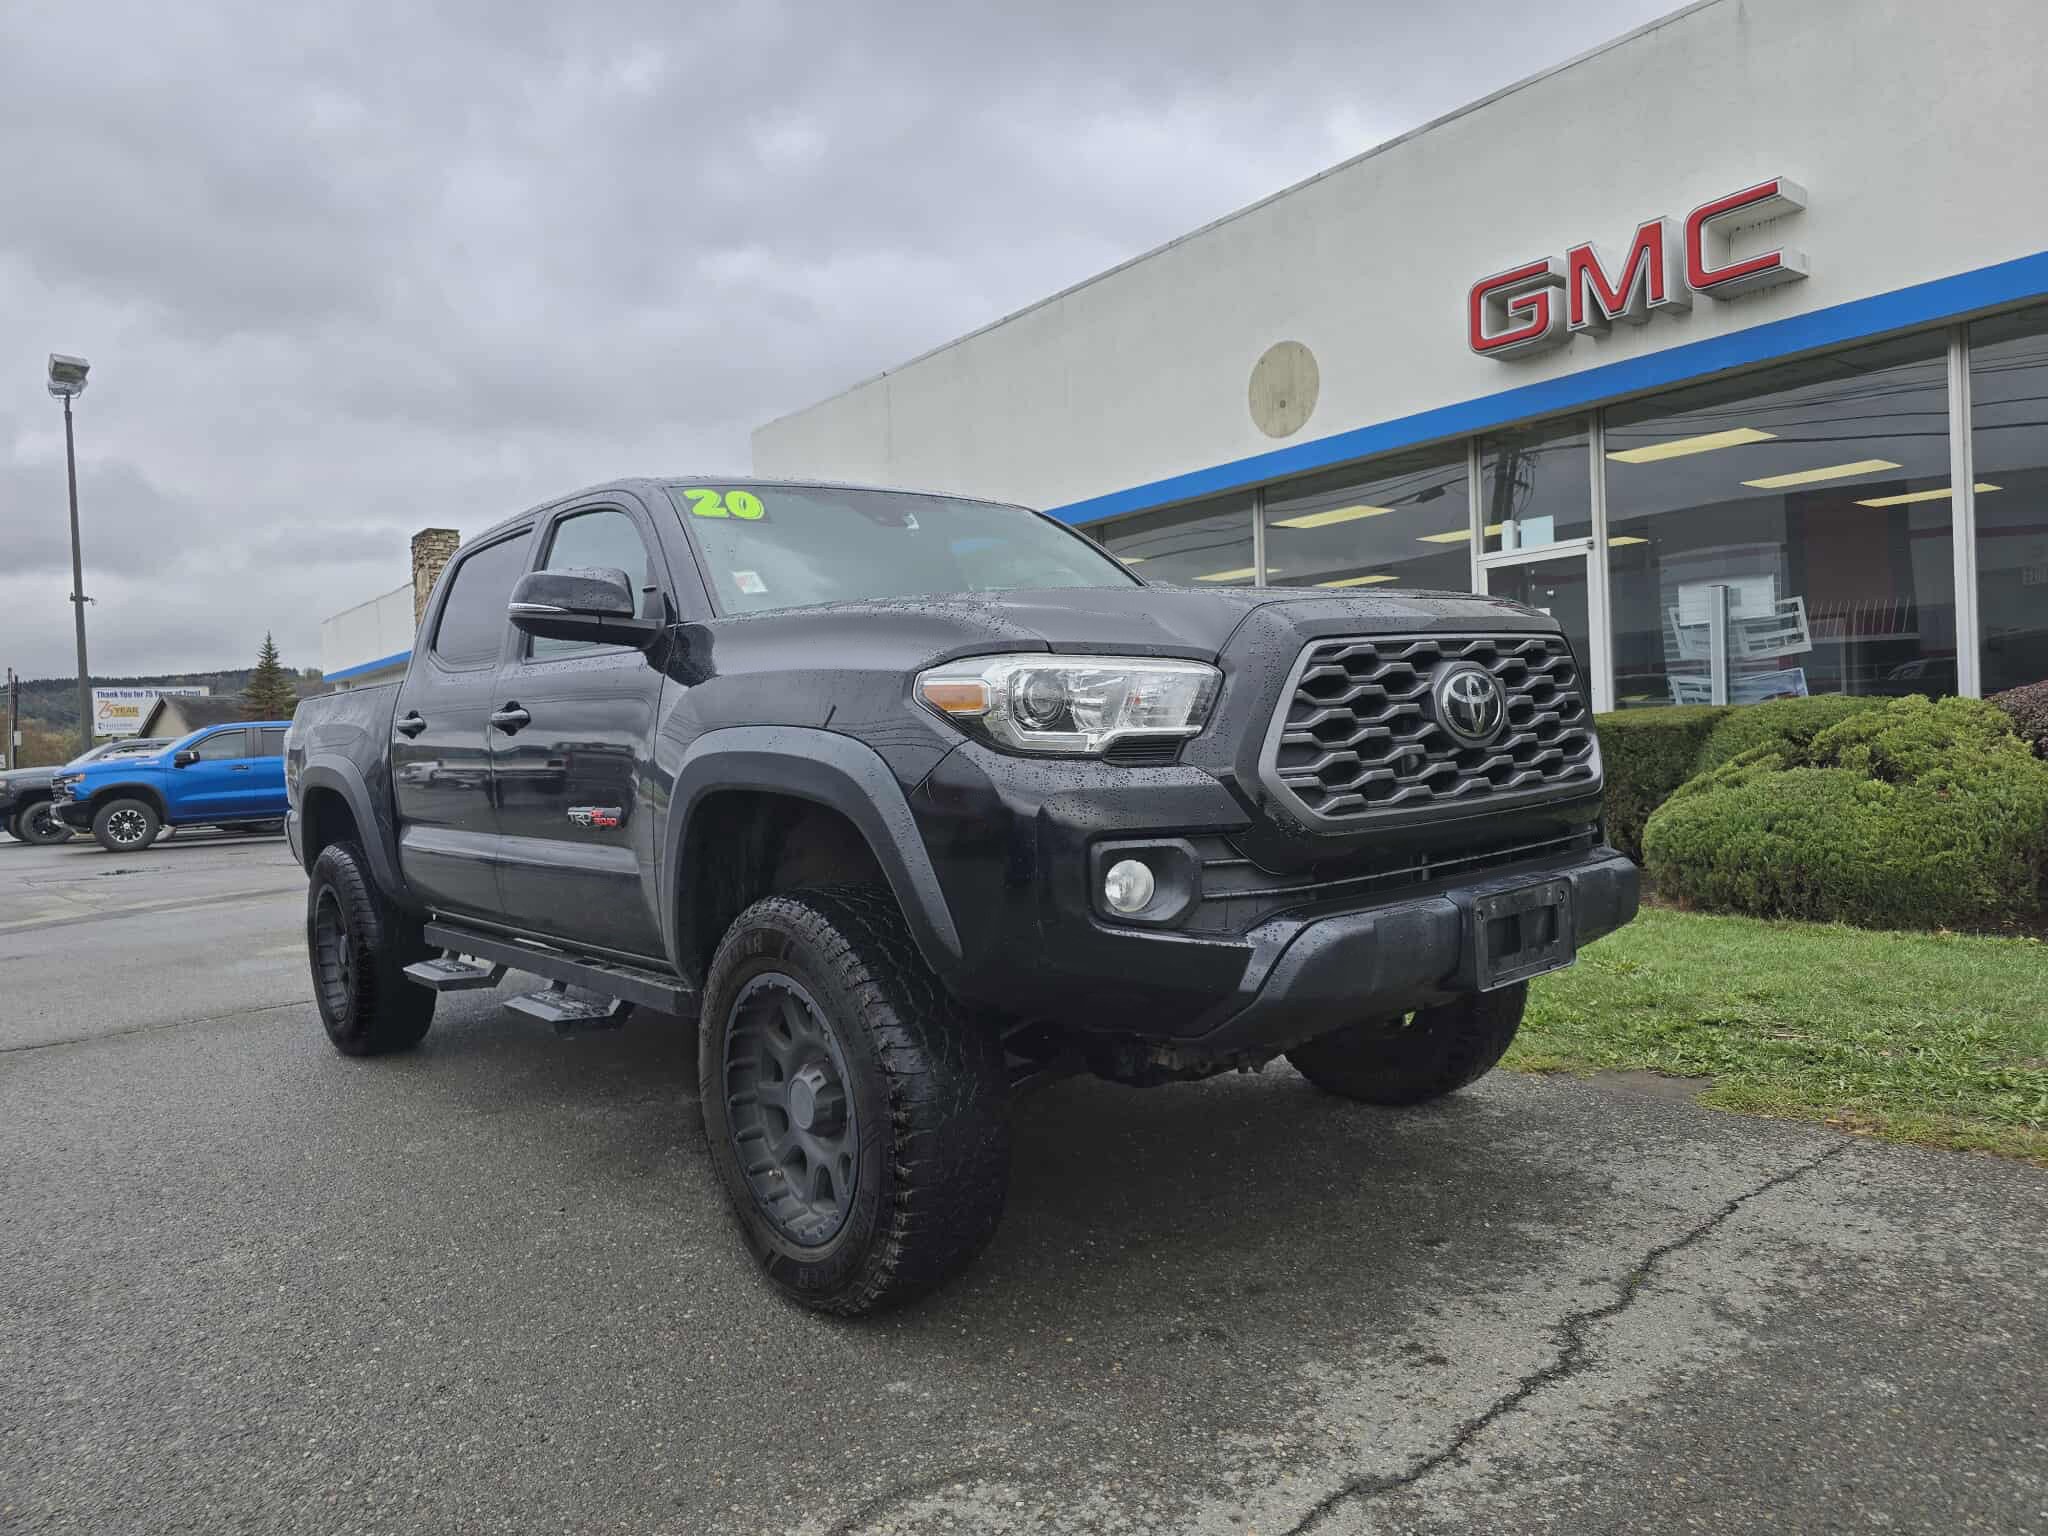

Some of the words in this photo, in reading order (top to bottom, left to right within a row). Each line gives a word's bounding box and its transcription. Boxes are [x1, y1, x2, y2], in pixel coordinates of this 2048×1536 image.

[1468, 176, 1802, 358] GMC
[683, 488, 765, 520] 20
[96, 690, 118, 698] Thank
[120, 690, 133, 698] You
[134, 690, 144, 698] for
[113, 706, 139, 714] YEAR
